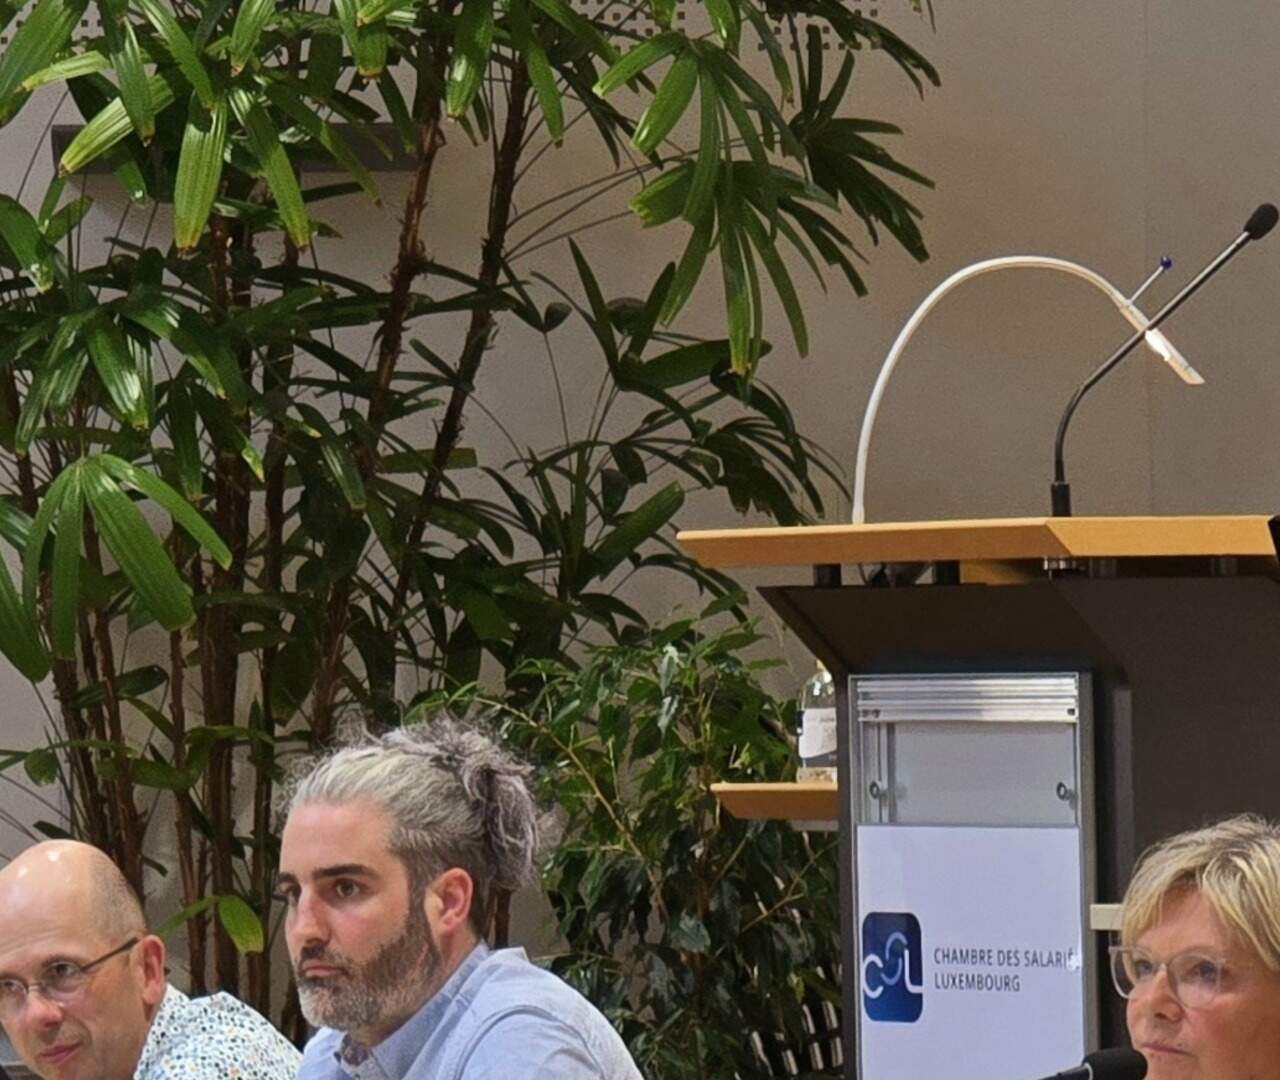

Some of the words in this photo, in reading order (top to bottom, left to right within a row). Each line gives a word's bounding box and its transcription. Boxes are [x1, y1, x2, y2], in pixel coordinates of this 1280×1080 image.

[933, 947, 993, 966] CHAMBRE
[996, 949, 1020, 967] DES
[1023, 946, 1081, 970] SALARIÉ
[933, 972, 1021, 992] LUXEMBOURG
